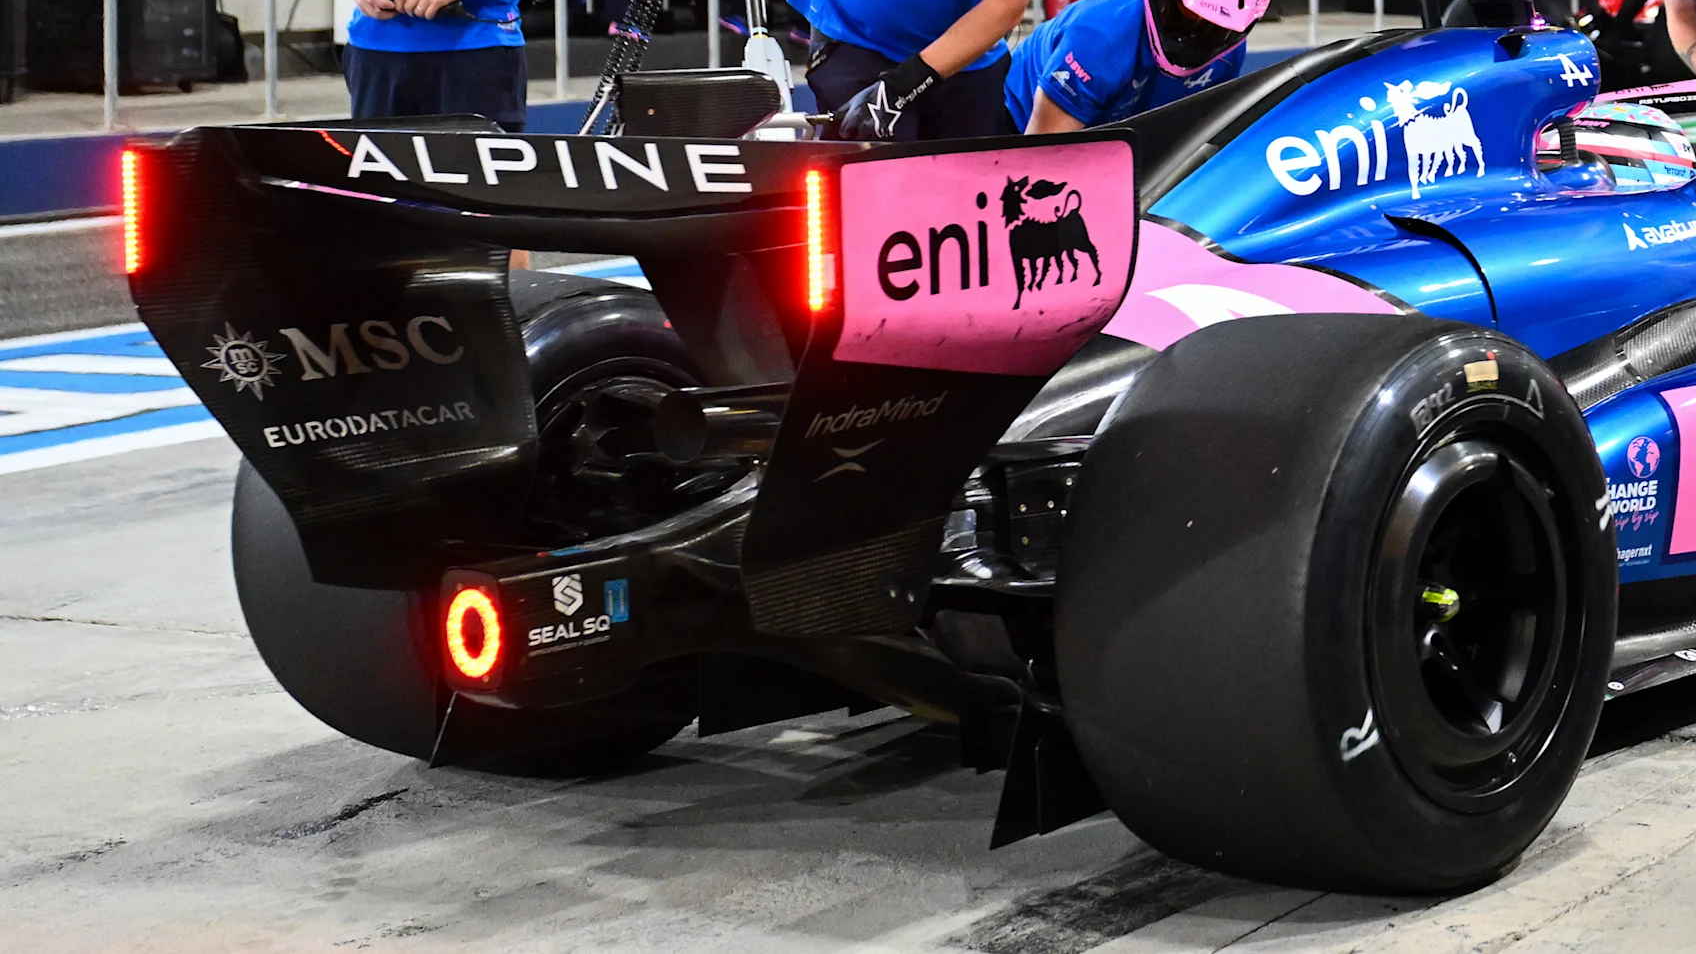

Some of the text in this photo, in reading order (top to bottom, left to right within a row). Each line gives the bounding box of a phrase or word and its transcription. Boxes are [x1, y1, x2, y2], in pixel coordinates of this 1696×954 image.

[347, 133, 753, 194] ALPINE
[1265, 96, 1388, 197] eni
[877, 191, 990, 301] eni
[279, 315, 464, 381] MSC
[263, 401, 475, 448] EURODATACAR
[805, 390, 949, 439] IndraMind
[1606, 480, 1659, 500] HANGE
[528, 621, 581, 647] SEAL
[583, 615, 612, 636] SQ
